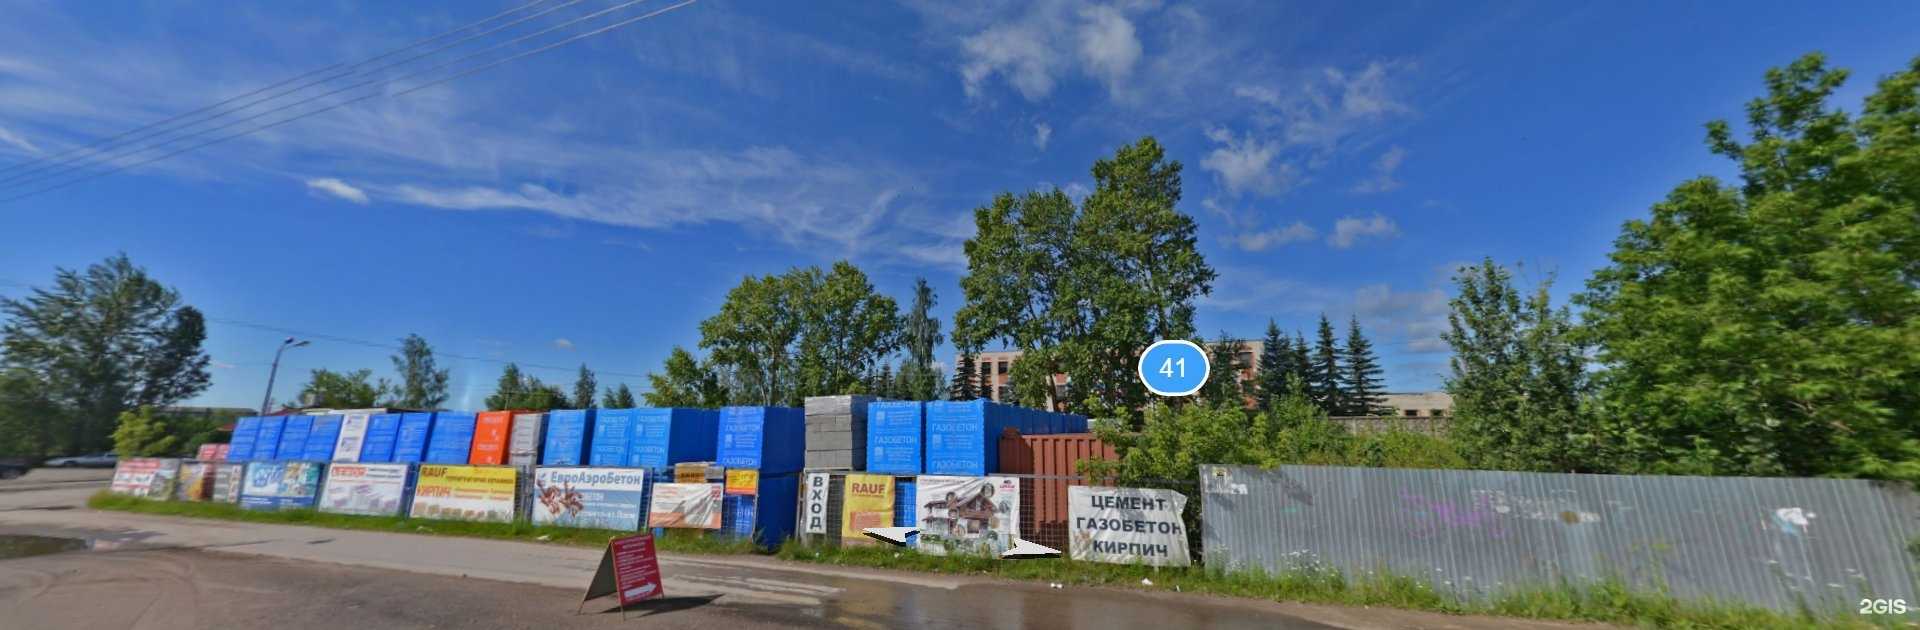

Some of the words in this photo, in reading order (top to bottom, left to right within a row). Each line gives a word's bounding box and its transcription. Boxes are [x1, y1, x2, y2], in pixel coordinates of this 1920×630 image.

[931, 423, 979, 432] ГАЗОБЕТОН
[550, 471, 641, 486] ЕвроАэроБетон
[851, 482, 885, 494] RAUF
[810, 476, 823, 530] ВХОД
[1091, 495, 1167, 511] ЦЕМЕНТ
[1076, 517, 1182, 535] ГАЗОБЕТОН
[1093, 540, 1168, 557] КИРПИЧ
